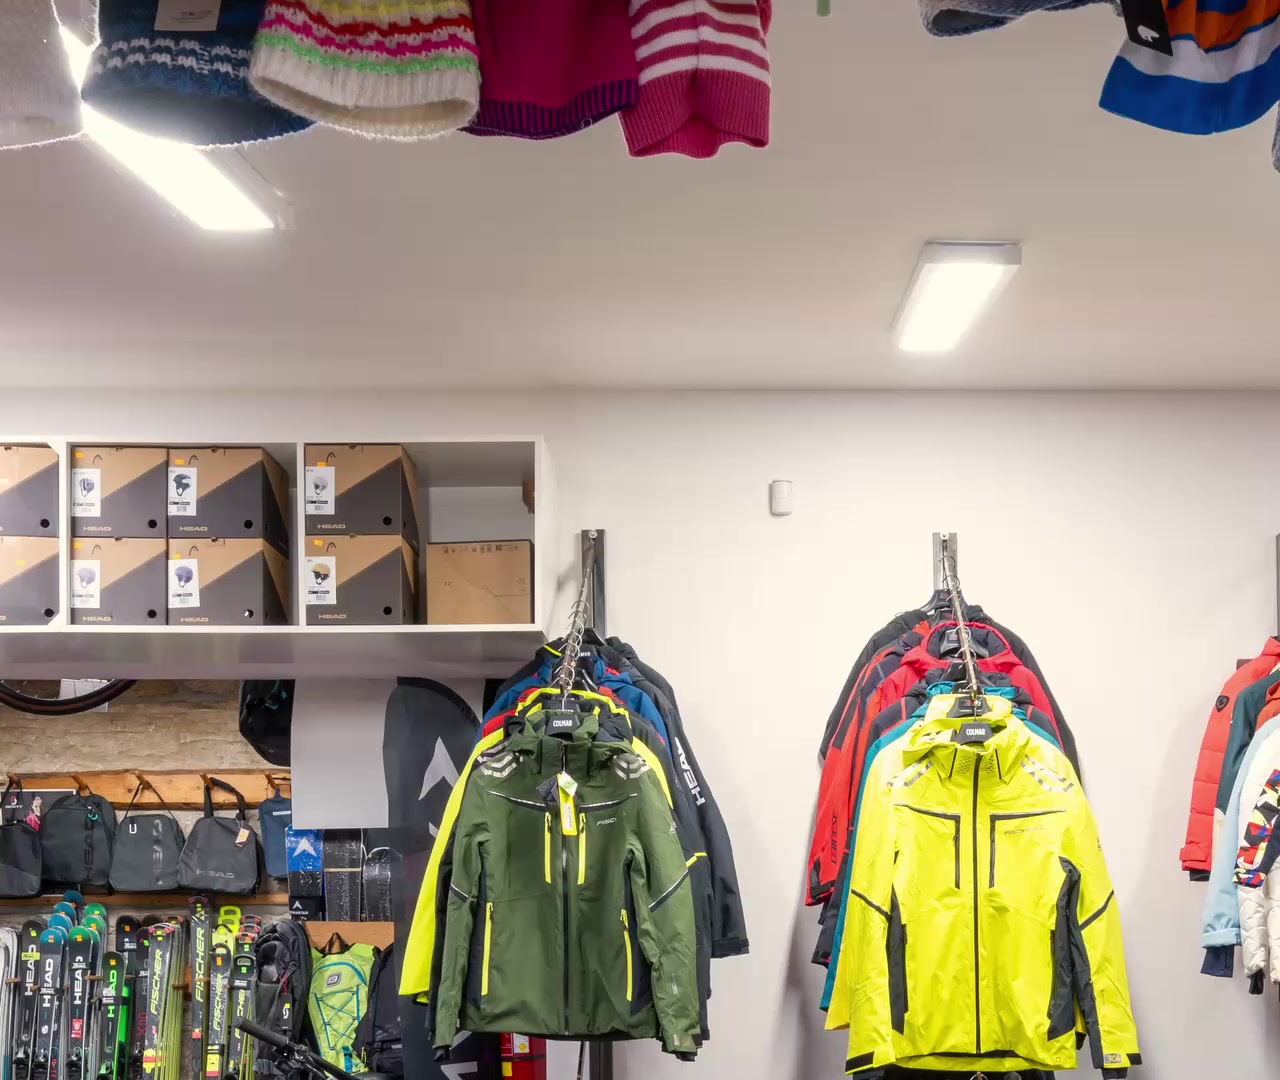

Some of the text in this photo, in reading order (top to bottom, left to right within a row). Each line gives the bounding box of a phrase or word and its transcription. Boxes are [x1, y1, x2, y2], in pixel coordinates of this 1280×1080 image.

[966, 728, 986, 736] COLMAR
[150, 949, 163, 1015] FISCHER
[196, 927, 205, 1003] FISCHER
[213, 973, 223, 1031] FISCHER
